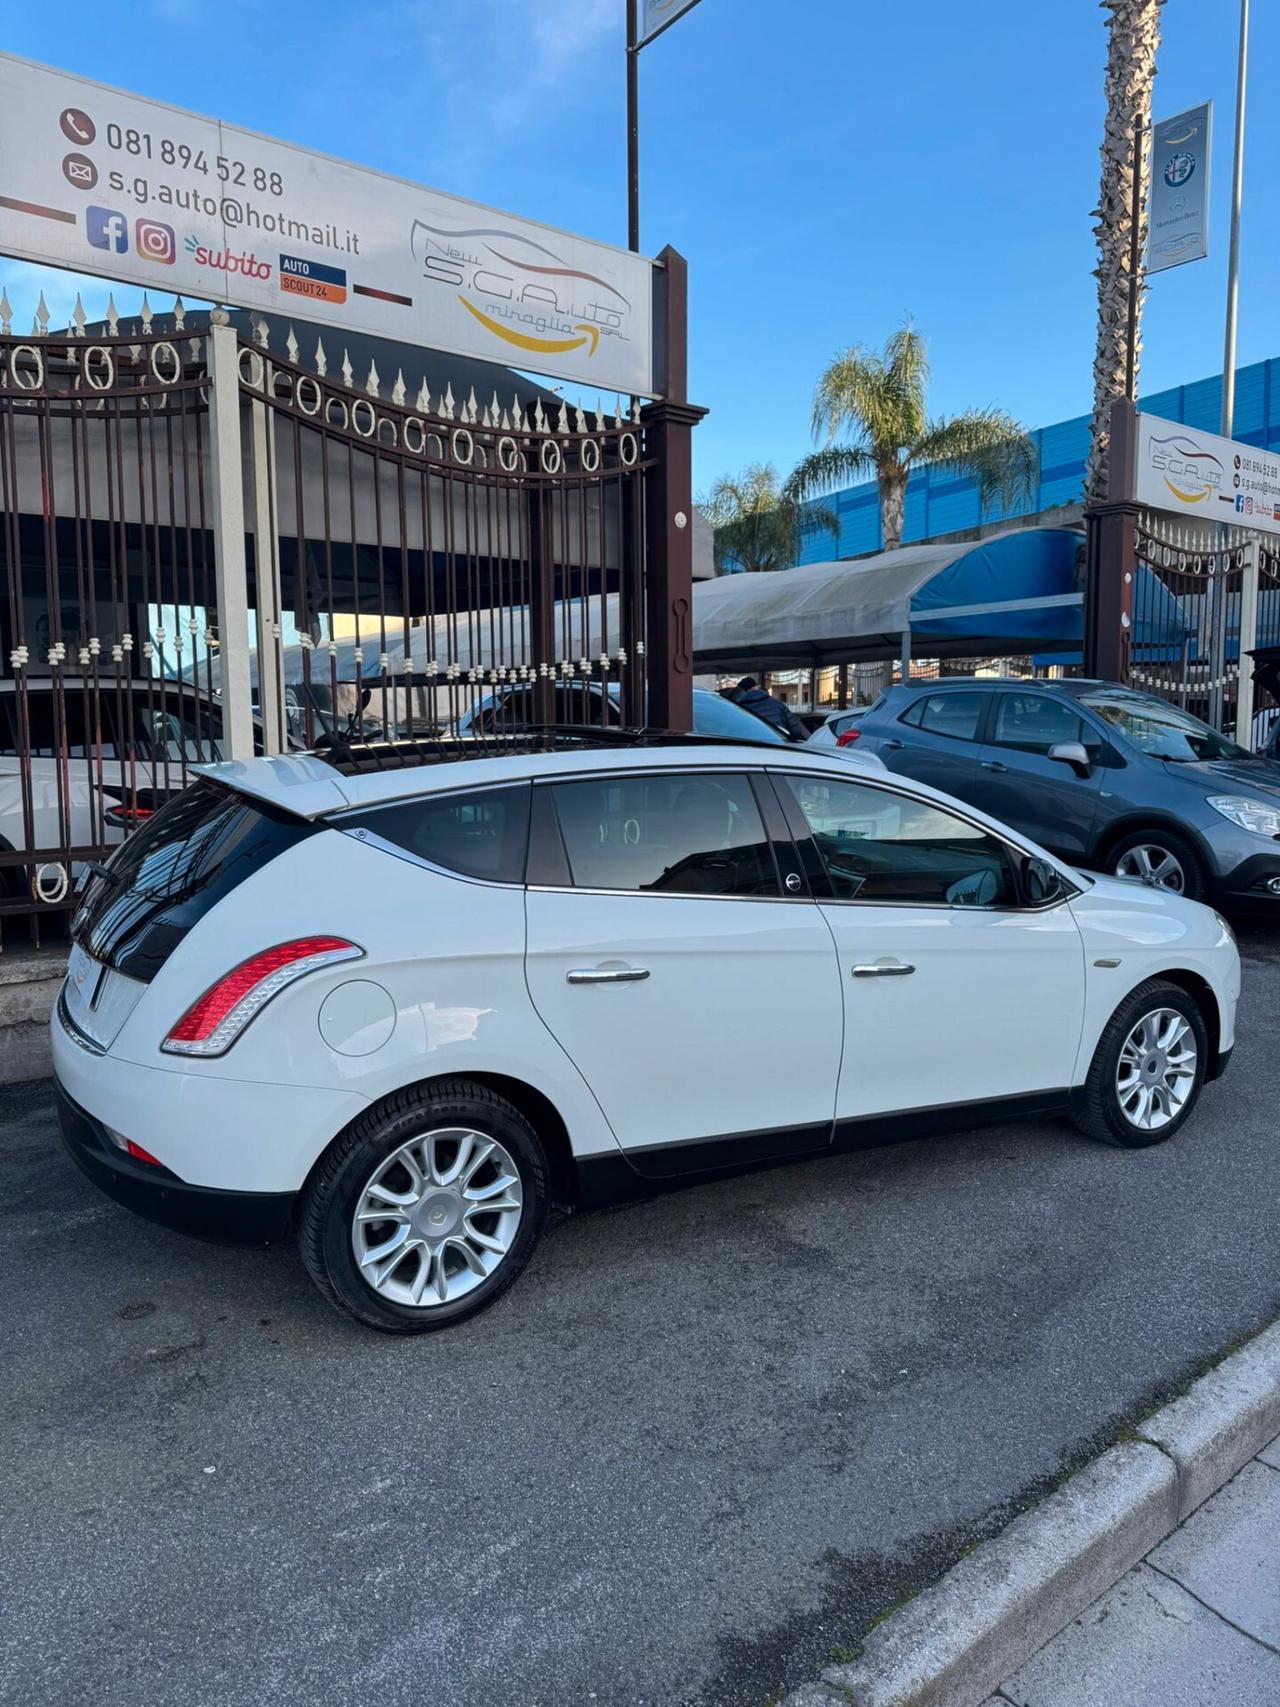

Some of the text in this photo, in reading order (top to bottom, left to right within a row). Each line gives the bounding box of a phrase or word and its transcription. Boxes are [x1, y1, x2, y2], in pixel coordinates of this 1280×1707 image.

[107, 123, 284, 197] 081 894 52 88
[109, 171, 360, 255] s.g.auto@hotmail.it
[194, 247, 273, 281] subito
[283, 258, 310, 275] AUTO
